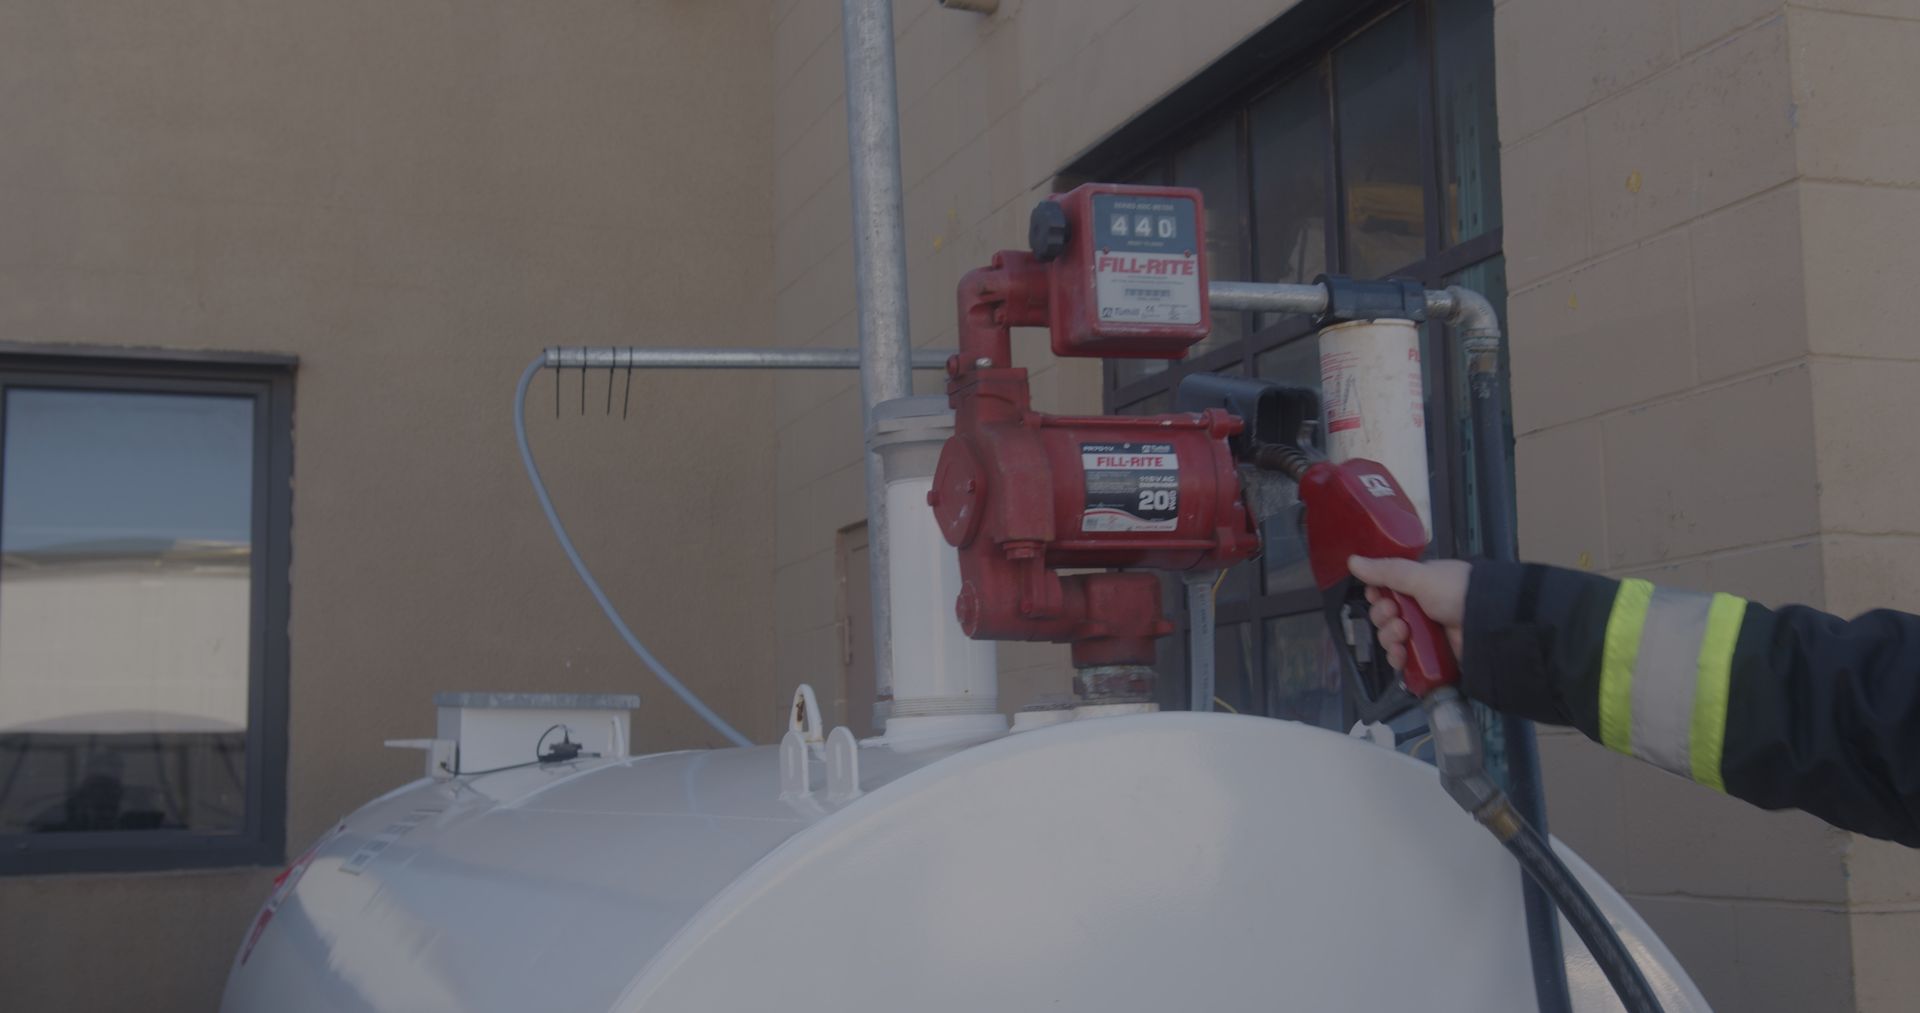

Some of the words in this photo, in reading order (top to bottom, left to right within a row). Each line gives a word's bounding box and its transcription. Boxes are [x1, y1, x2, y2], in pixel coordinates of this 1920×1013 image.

[1099, 257, 1194, 275] FILL-RITE
[1096, 457, 1164, 467] FILL-RITE
[1139, 490, 1168, 511] 20
